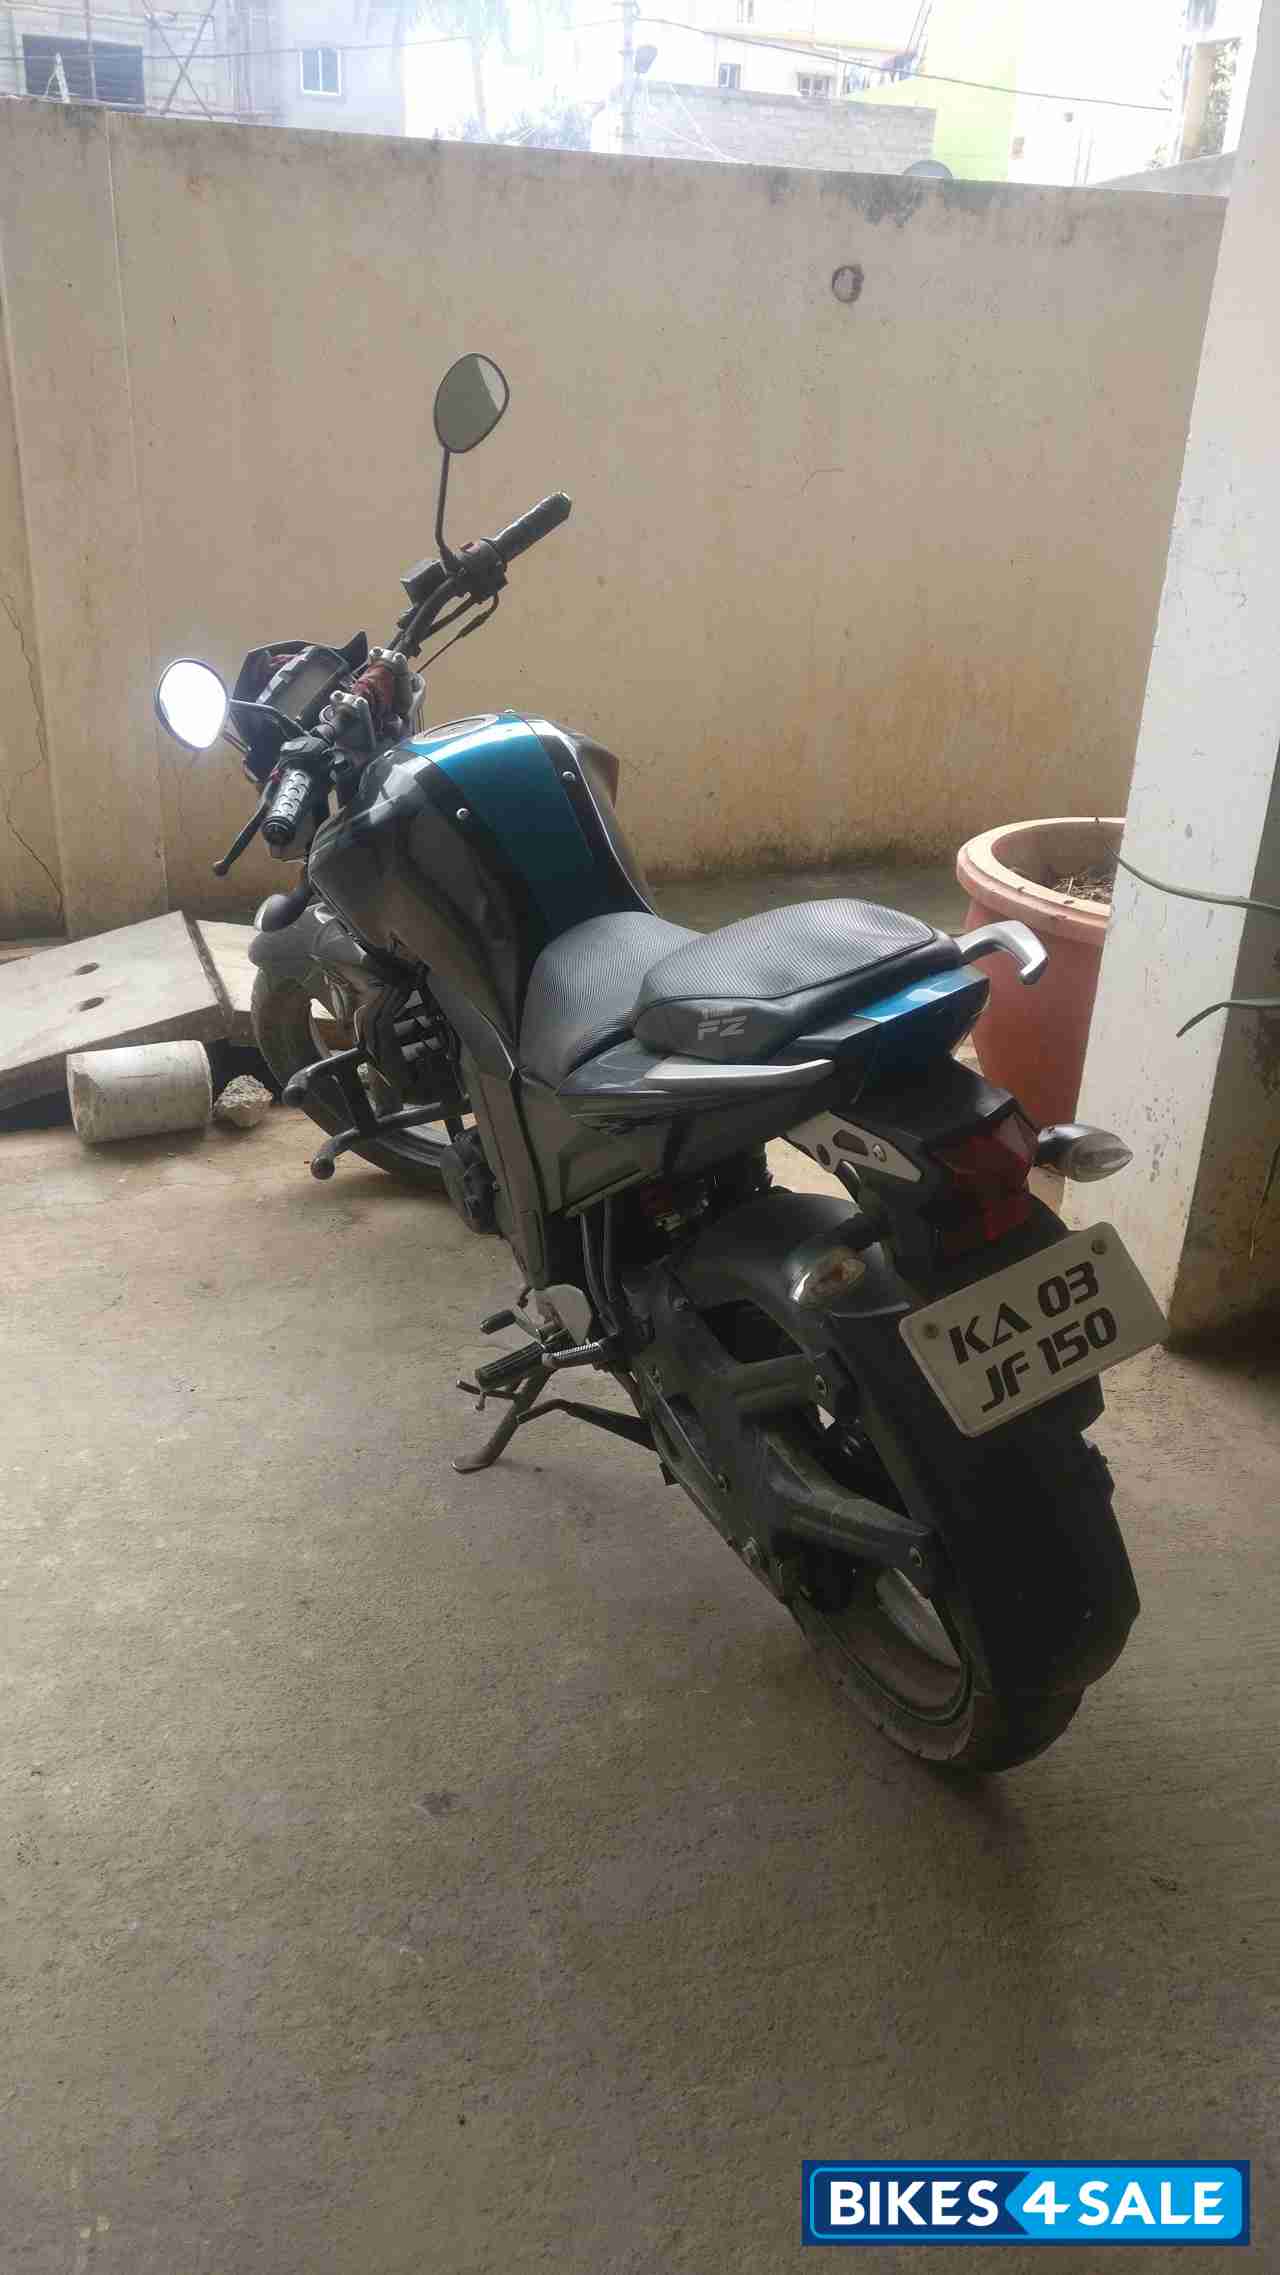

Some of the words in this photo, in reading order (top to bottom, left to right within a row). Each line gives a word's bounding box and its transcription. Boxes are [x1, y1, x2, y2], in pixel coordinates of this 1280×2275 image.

[948, 1301, 1033, 1365] KA
[1037, 1260, 1099, 1318] 03
[980, 1350, 1031, 1413] JF
[1036, 1306, 1118, 1375] 150
